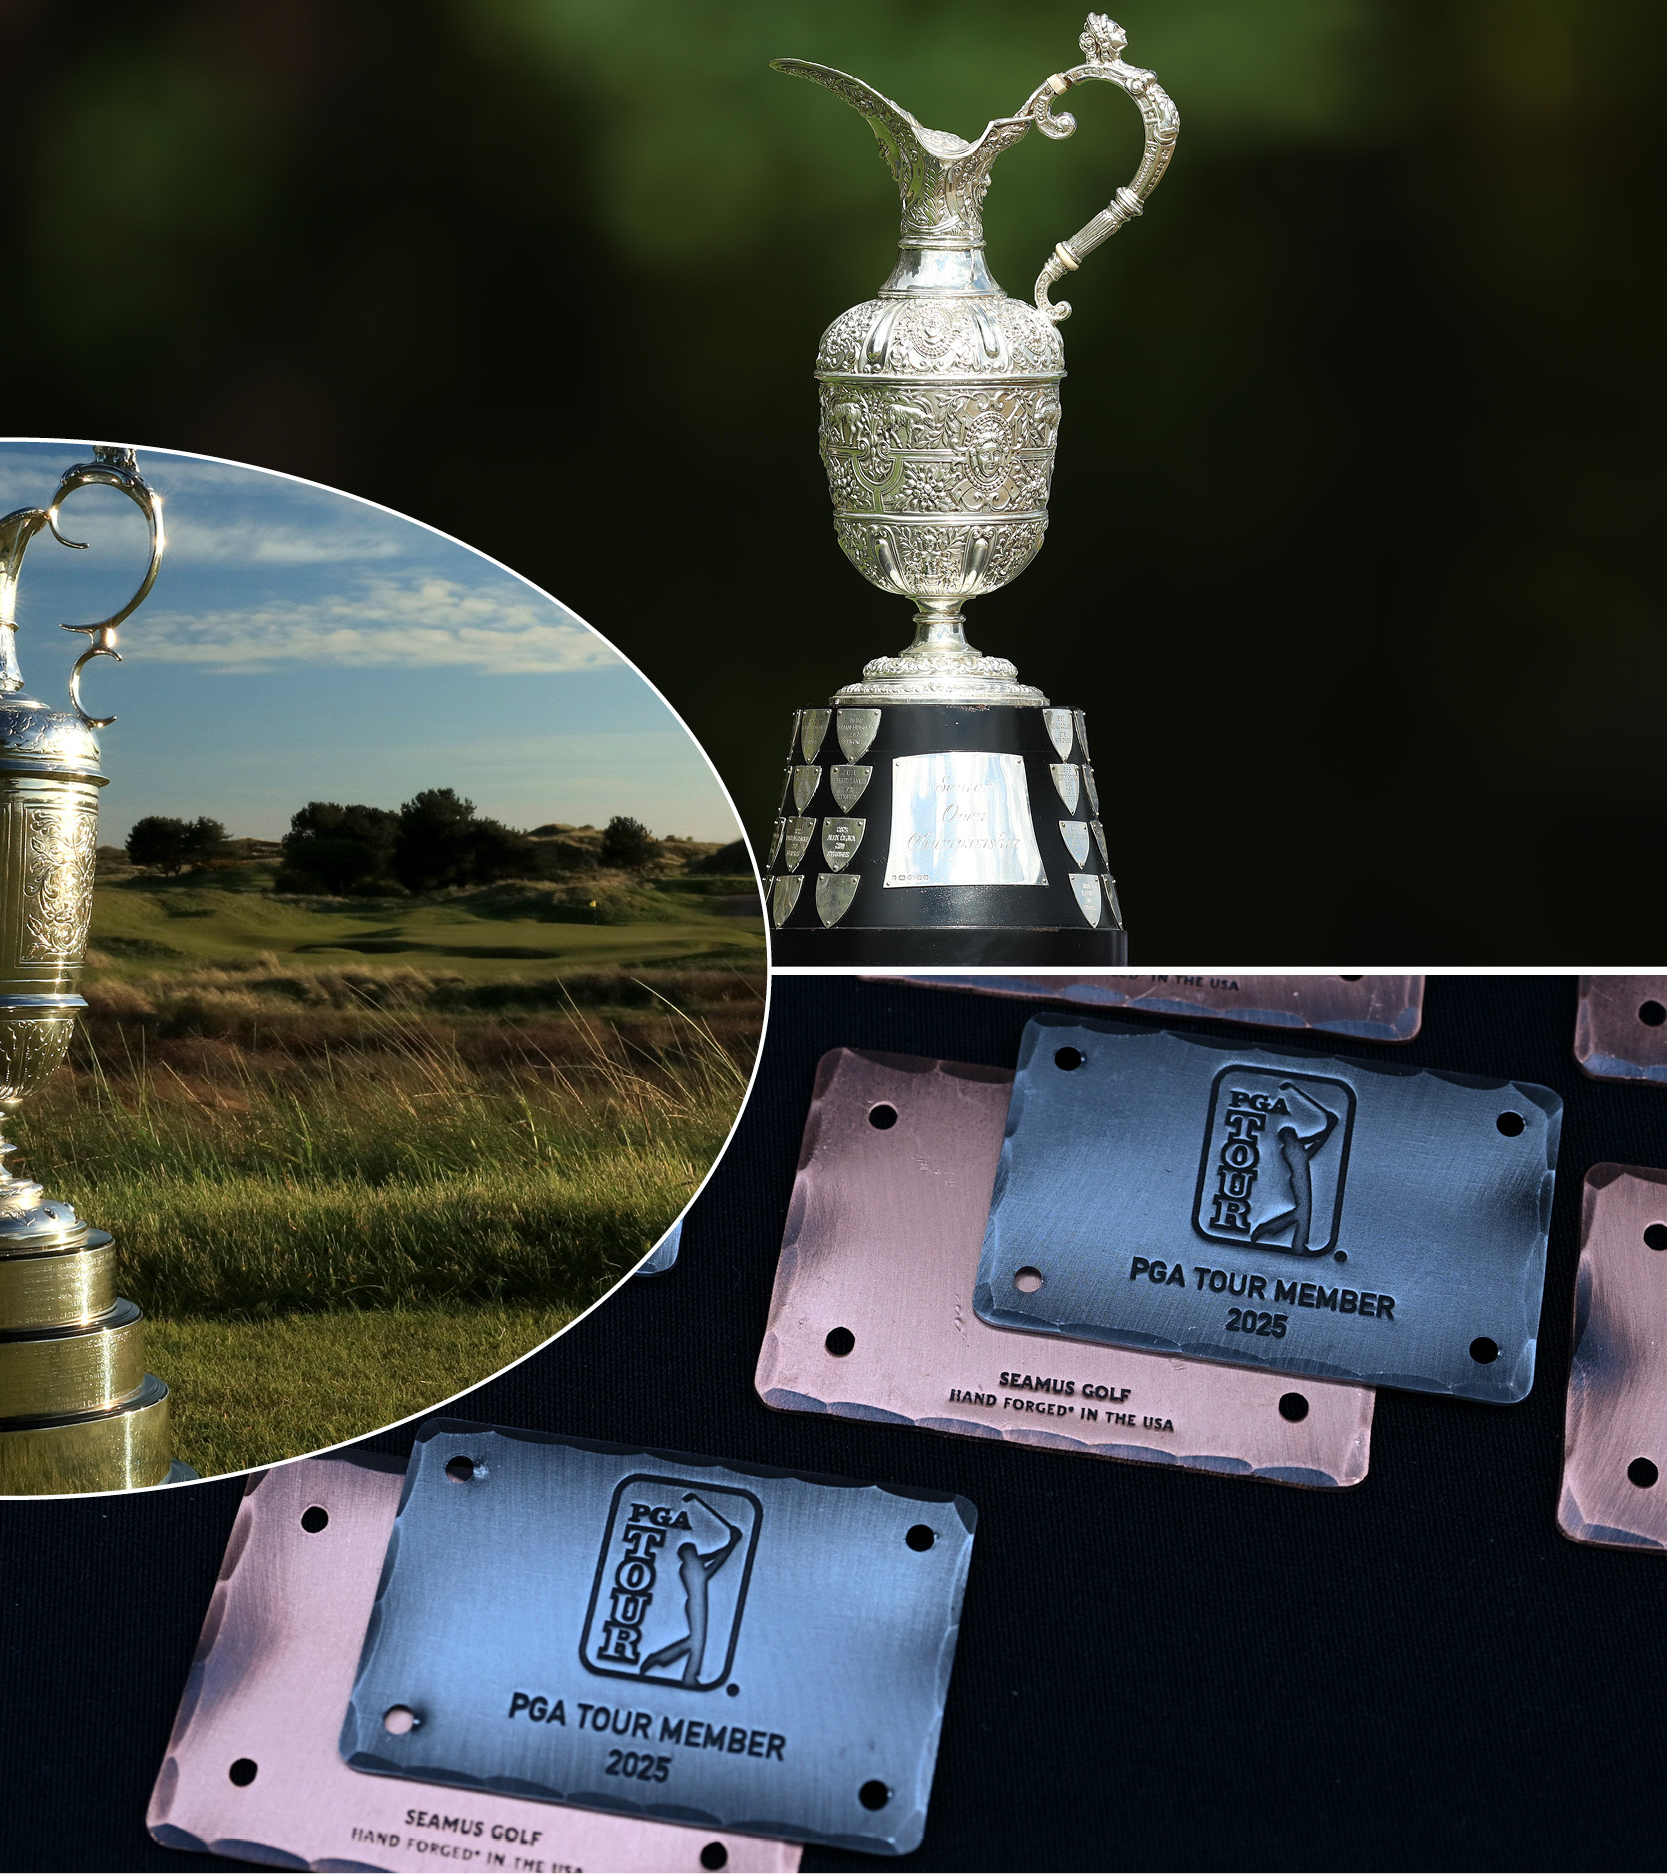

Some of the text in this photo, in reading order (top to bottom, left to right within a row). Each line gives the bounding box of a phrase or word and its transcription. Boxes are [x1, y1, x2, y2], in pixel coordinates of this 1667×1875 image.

[935, 776, 993, 794] Senior
[942, 803, 986, 824] Open
[1175, 975, 1204, 987] THE
[1211, 978, 1239, 991] USA
[1229, 1090, 1291, 1116] PGA
[1209, 1108, 1267, 1234] TOUR
[1129, 1256, 1396, 1321] PGA TOUR MEMBER
[1224, 1307, 1289, 1339] 2025
[999, 1371, 1132, 1404] SEAMUS GOLF
[949, 1388, 997, 1407] HAND
[1081, 1407, 1099, 1421] IN
[1105, 1411, 1137, 1427] THE
[1143, 1416, 1175, 1433] USA
[628, 1503, 693, 1531] PGA
[597, 1524, 668, 1666] TOUR
[508, 1691, 787, 1762] PGA TOUR MEMBER
[605, 1749, 673, 1783] 2025
[404, 1808, 543, 1847] SEAMUS GOLF
[350, 1827, 401, 1848] HAND
[486, 1851, 506, 1867] IN
[514, 1856, 545, 1873] THE
